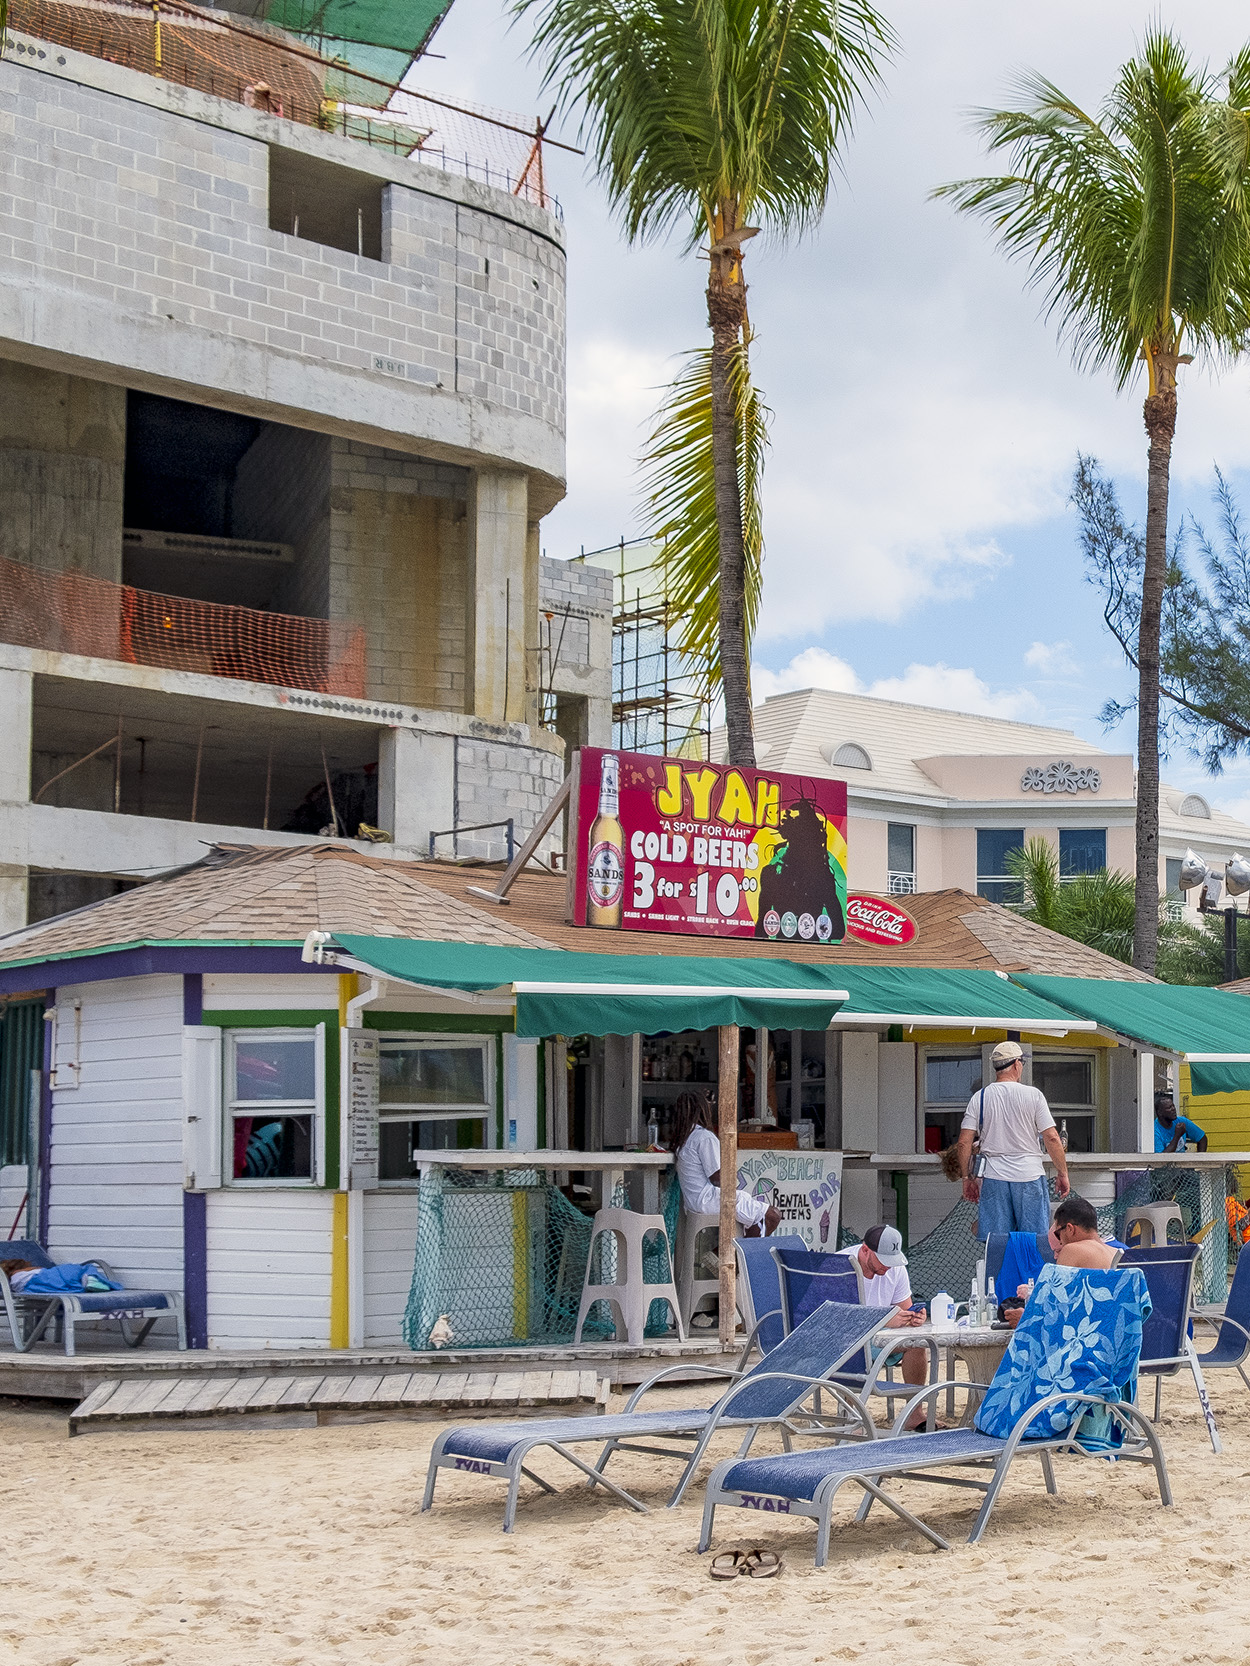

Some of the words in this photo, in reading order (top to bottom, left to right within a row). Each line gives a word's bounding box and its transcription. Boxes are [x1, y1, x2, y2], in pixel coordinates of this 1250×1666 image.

[656, 762, 781, 829] JYAH
[673, 821, 700, 834] SPOT
[701, 825, 722, 836] FOR
[630, 830, 688, 863] COLD
[693, 836, 759, 870] BEERS
[588, 867, 624, 881] SANDS
[633, 861, 655, 909] 3
[657, 877, 684, 898] for
[863, 900, 882, 910] DRINK
[624, 911, 640, 919] SANDS
[865, 926, 876, 934] AND
[776, 1156, 824, 1181] BEACH
[808, 1172, 841, 1210] BAR
[772, 1188, 810, 1208] RENTAL
[780, 1208, 812, 1221] ITEMS
[455, 1457, 491, 1475] JYAH
[739, 1494, 790, 1514] JYAH
